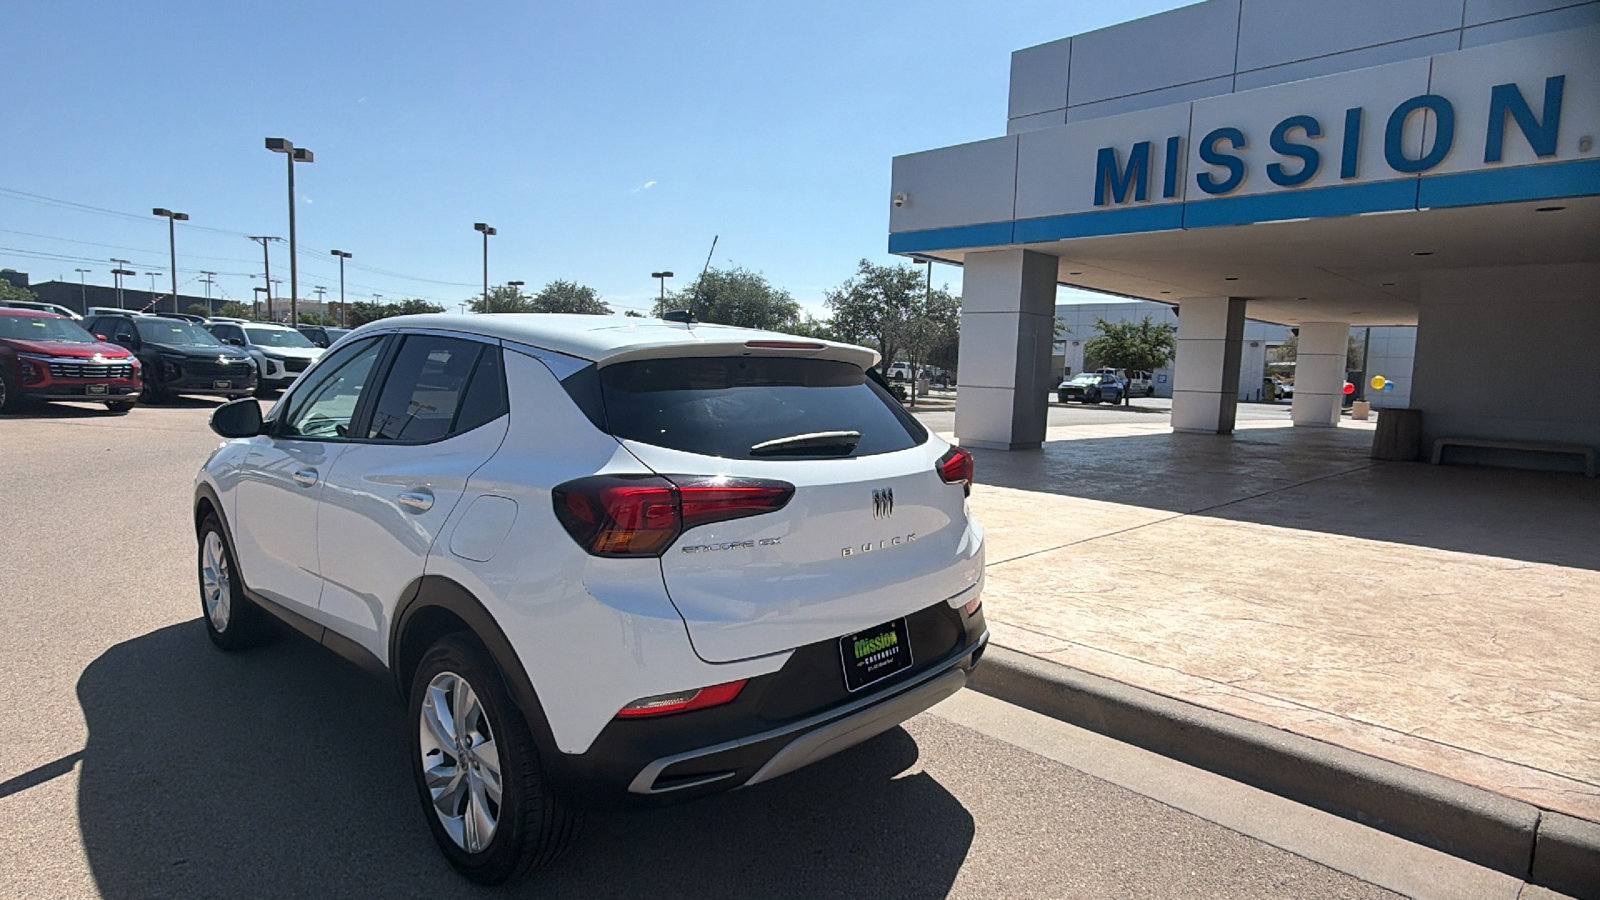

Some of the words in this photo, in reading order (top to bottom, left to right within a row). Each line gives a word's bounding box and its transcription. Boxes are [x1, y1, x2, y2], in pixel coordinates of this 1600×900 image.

[1094, 75, 1566, 206] MISSION
[682, 539, 754, 554] ENCORE
[759, 536, 781, 546] GX
[842, 533, 917, 557] BUICK
[854, 632, 898, 658] Mission
